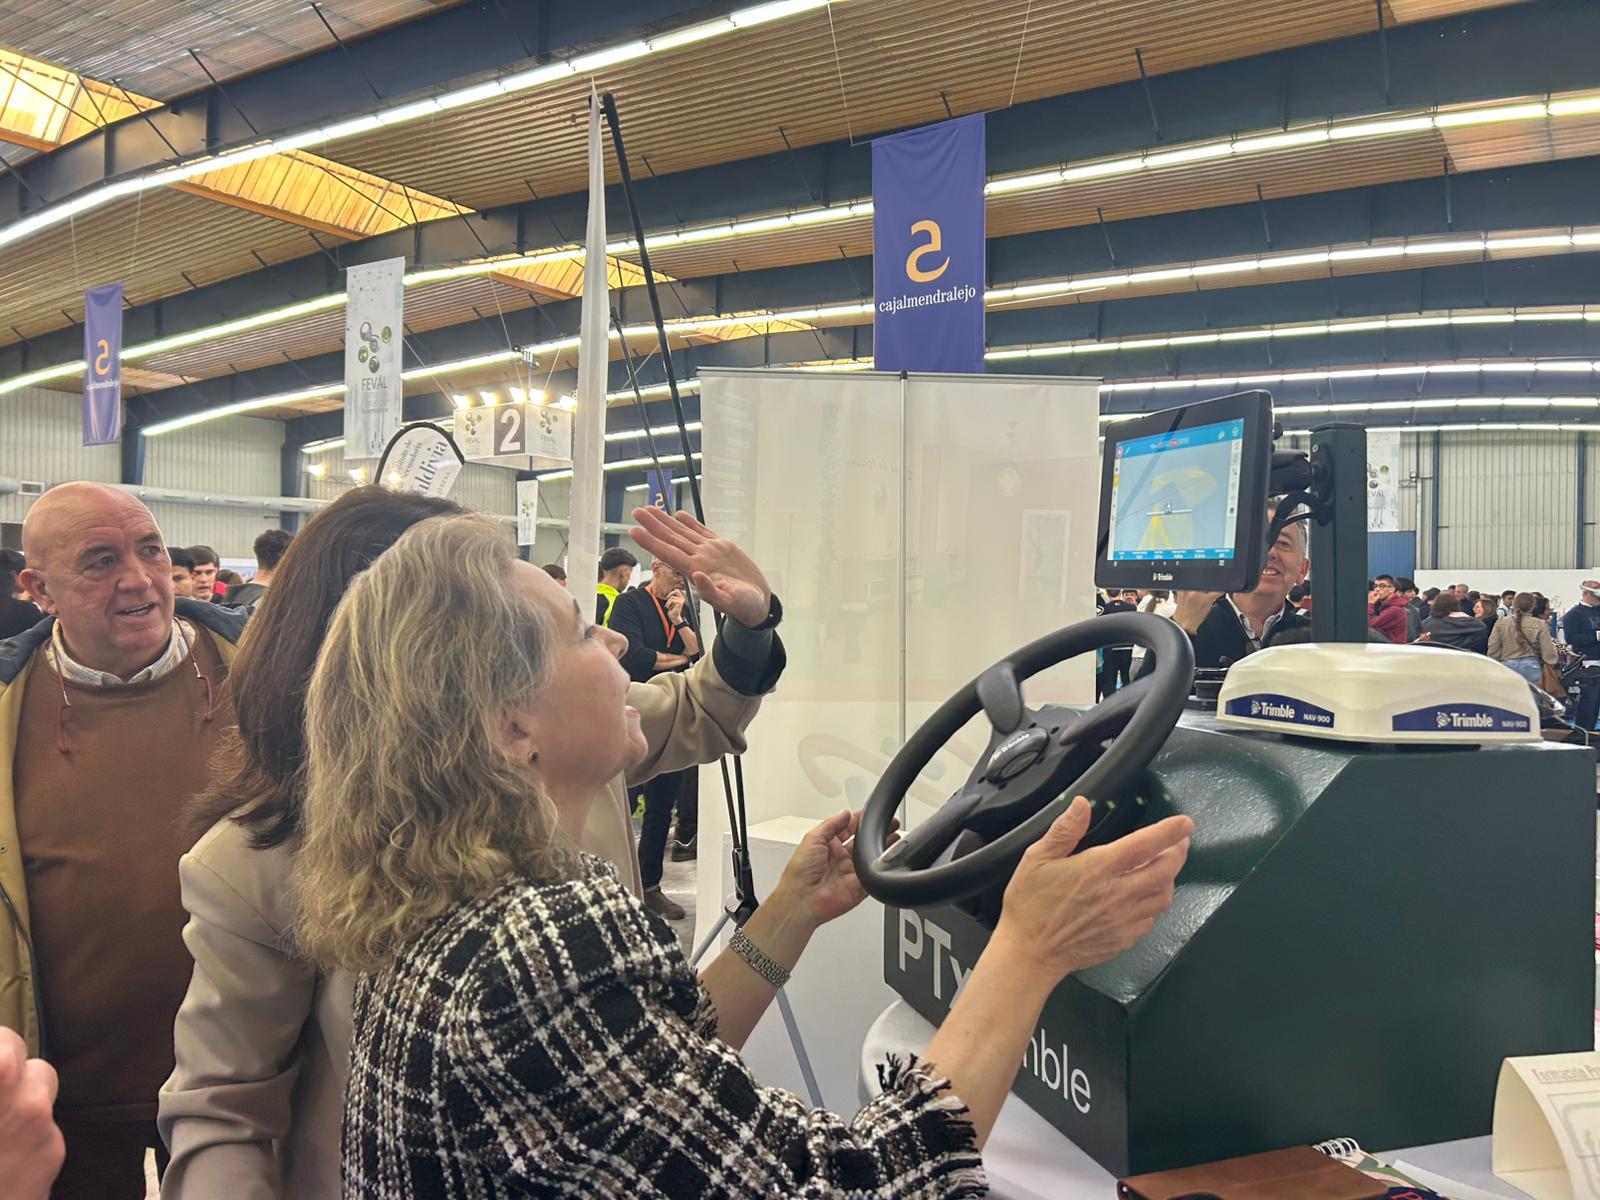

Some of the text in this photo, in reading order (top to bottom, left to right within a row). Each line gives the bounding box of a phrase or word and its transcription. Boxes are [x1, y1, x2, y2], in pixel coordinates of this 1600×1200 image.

[879, 285, 976, 314] cajalmendralejo
[361, 376, 388, 391] FEVAL
[500, 408, 520, 452] 2
[412, 441, 449, 495] aldivia
[1261, 702, 1330, 724] Trimble NAV-900
[1450, 712, 1493, 727] Trimble
[1021, 1027, 1091, 1114] mble
